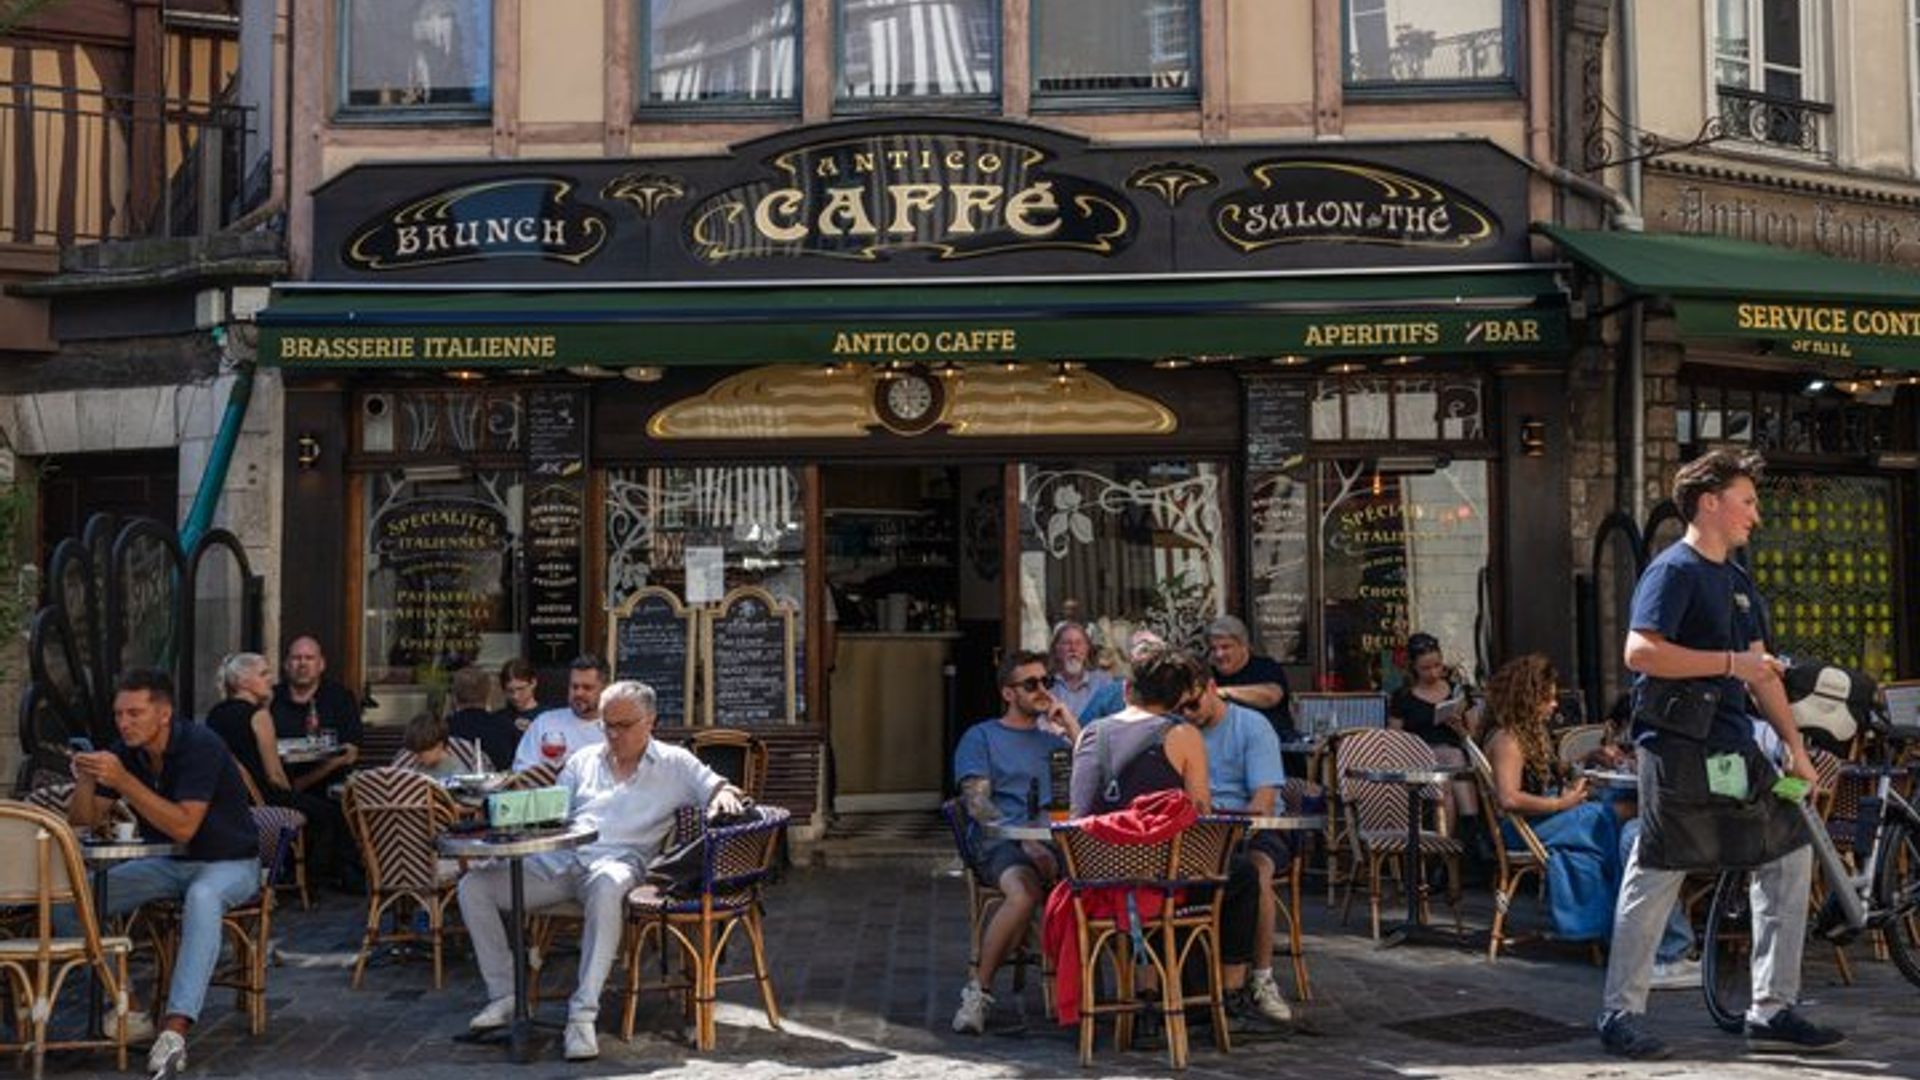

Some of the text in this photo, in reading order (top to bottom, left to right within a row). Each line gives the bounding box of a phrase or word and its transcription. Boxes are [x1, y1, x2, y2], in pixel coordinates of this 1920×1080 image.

[816, 150, 1003, 177] ANTICO
[1245, 200, 1364, 234] SALON
[395, 216, 567, 257] BRUNCH
[1737, 303, 1848, 333] SERVICE
[280, 336, 556, 359] BRASSERIE ITALIENNE
[833, 330, 1018, 355] ANTICO CAFFE
[1304, 323, 1440, 347] APERITIFS
